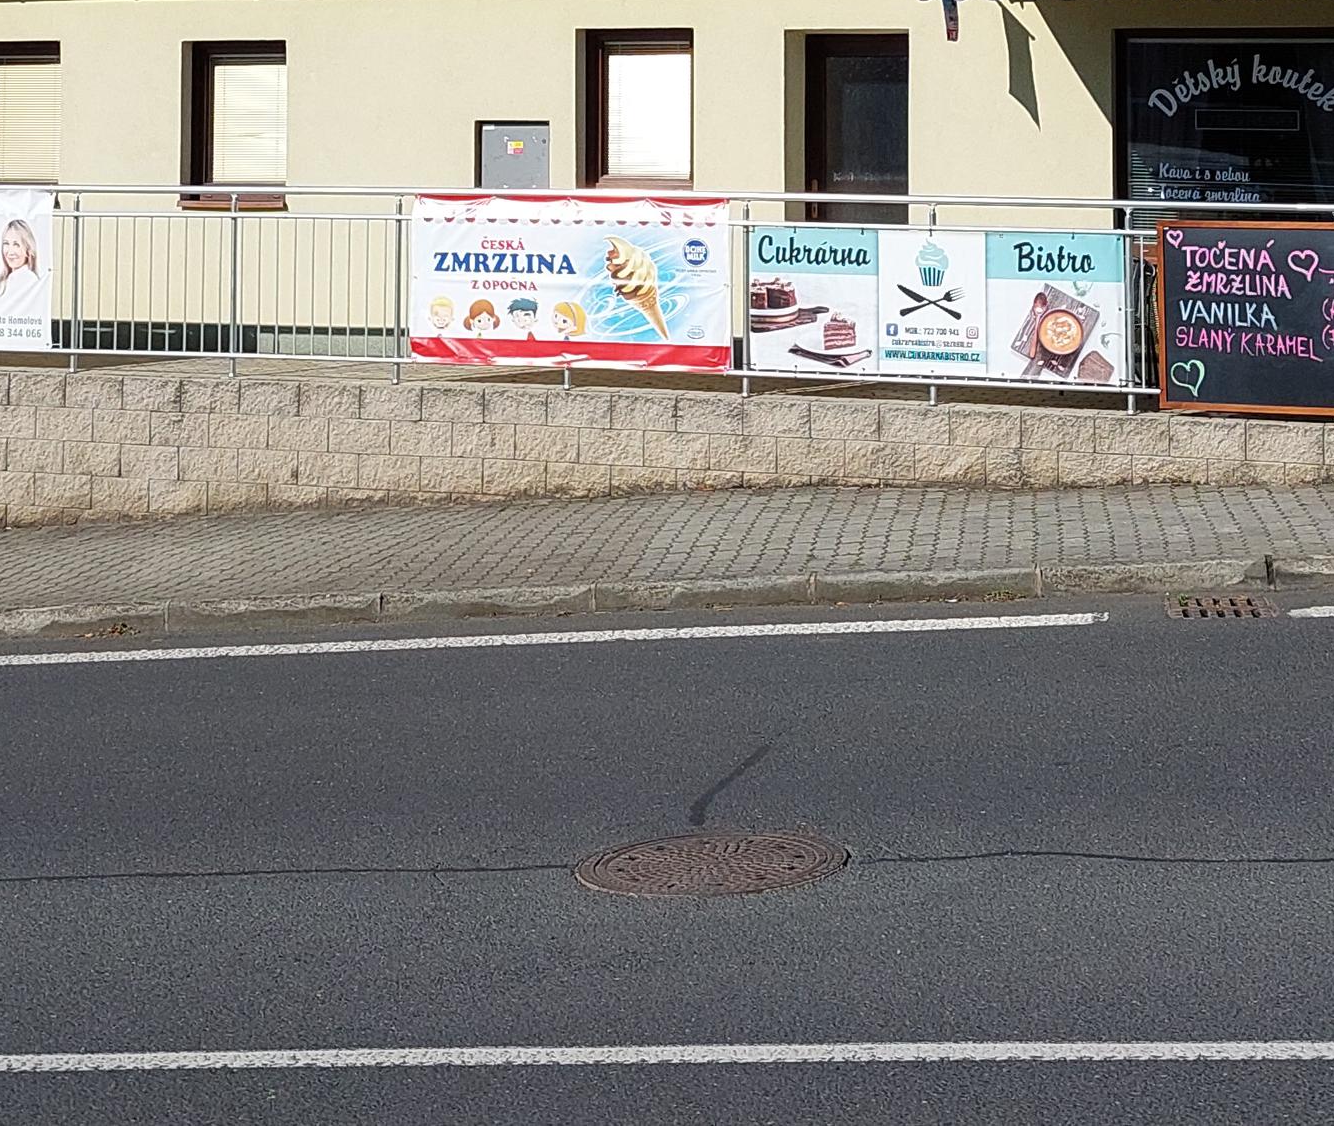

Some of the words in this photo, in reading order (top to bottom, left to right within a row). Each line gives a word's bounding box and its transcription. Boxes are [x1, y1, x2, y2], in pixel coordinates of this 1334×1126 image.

[1147, 58, 1242, 117] Dětský
[1195, 166, 1201, 180] i
[1215, 166, 1251, 182] sebou
[1204, 186, 1261, 203] zmrzlina
[481, 236, 525, 250] ČESKÁ
[758, 235, 871, 266] Cukrárna
[1181, 240, 1275, 272] TOČENÁ
[433, 252, 577, 274] ZMRZLINA
[1013, 241, 1095, 273] Bistro
[471, 280, 479, 289] Z
[482, 277, 537, 291] OPOČNA
[1179, 299, 1278, 331] VANILKA
[7, 328, 23, 337] 344
[25, 328, 42, 338] 066
[1175, 326, 1235, 353] SLANÝ
[1240, 331, 1323, 363] KARAMEL
